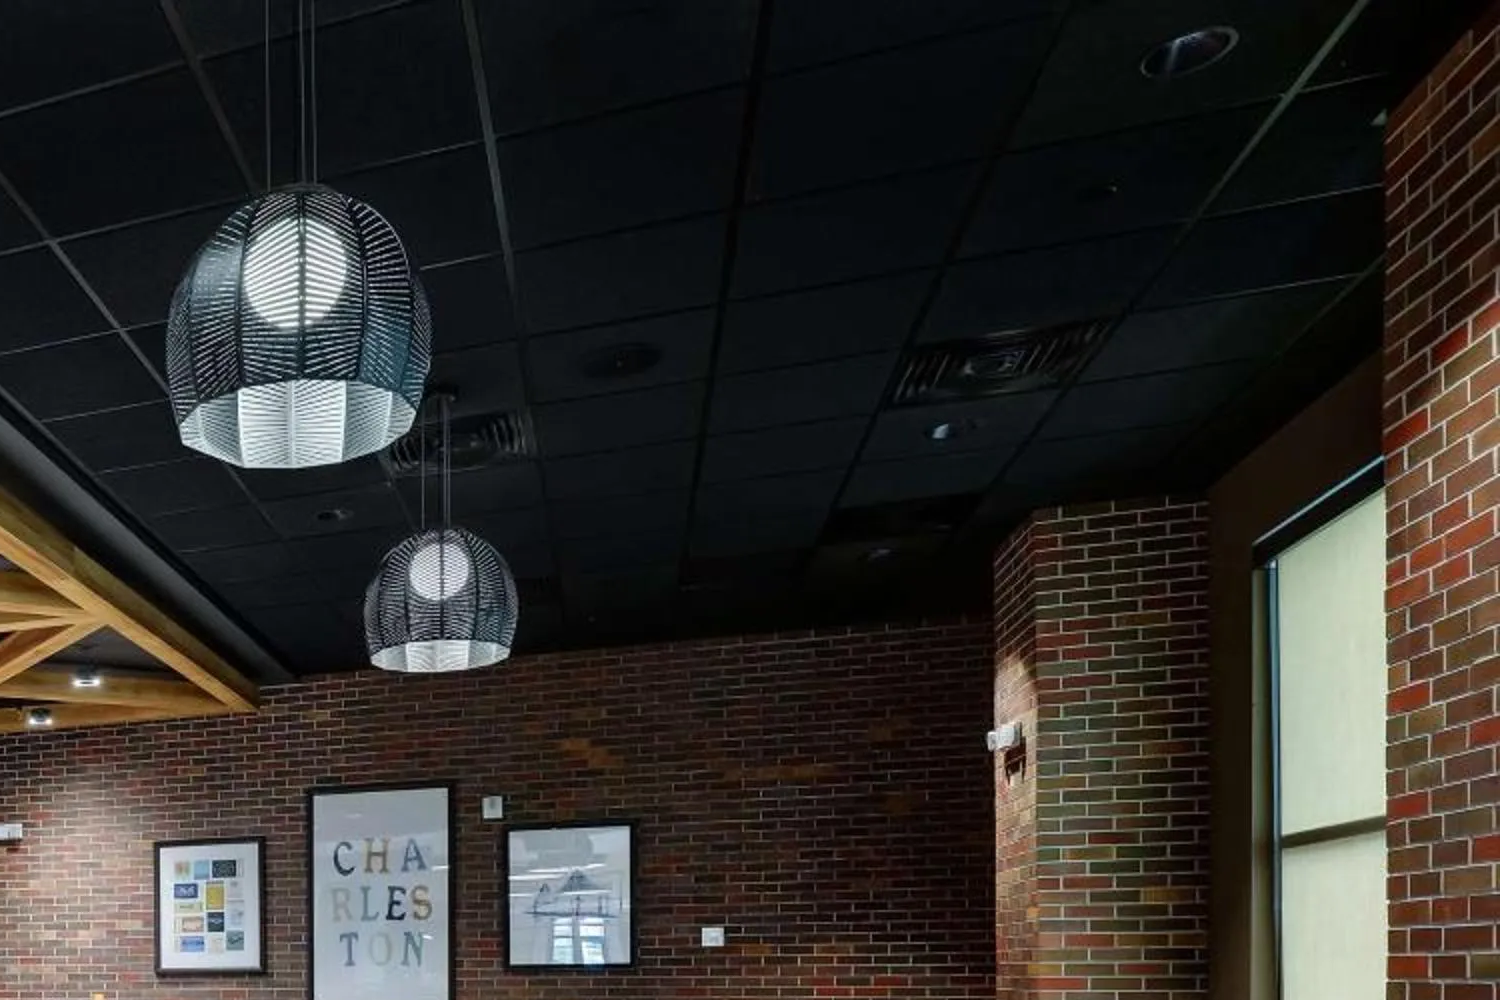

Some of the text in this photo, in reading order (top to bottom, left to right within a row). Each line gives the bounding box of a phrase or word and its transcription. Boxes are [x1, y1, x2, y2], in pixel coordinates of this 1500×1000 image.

[332, 838, 428, 876] CHA
[331, 885, 432, 921] RLES
[339, 931, 424, 967] TON
